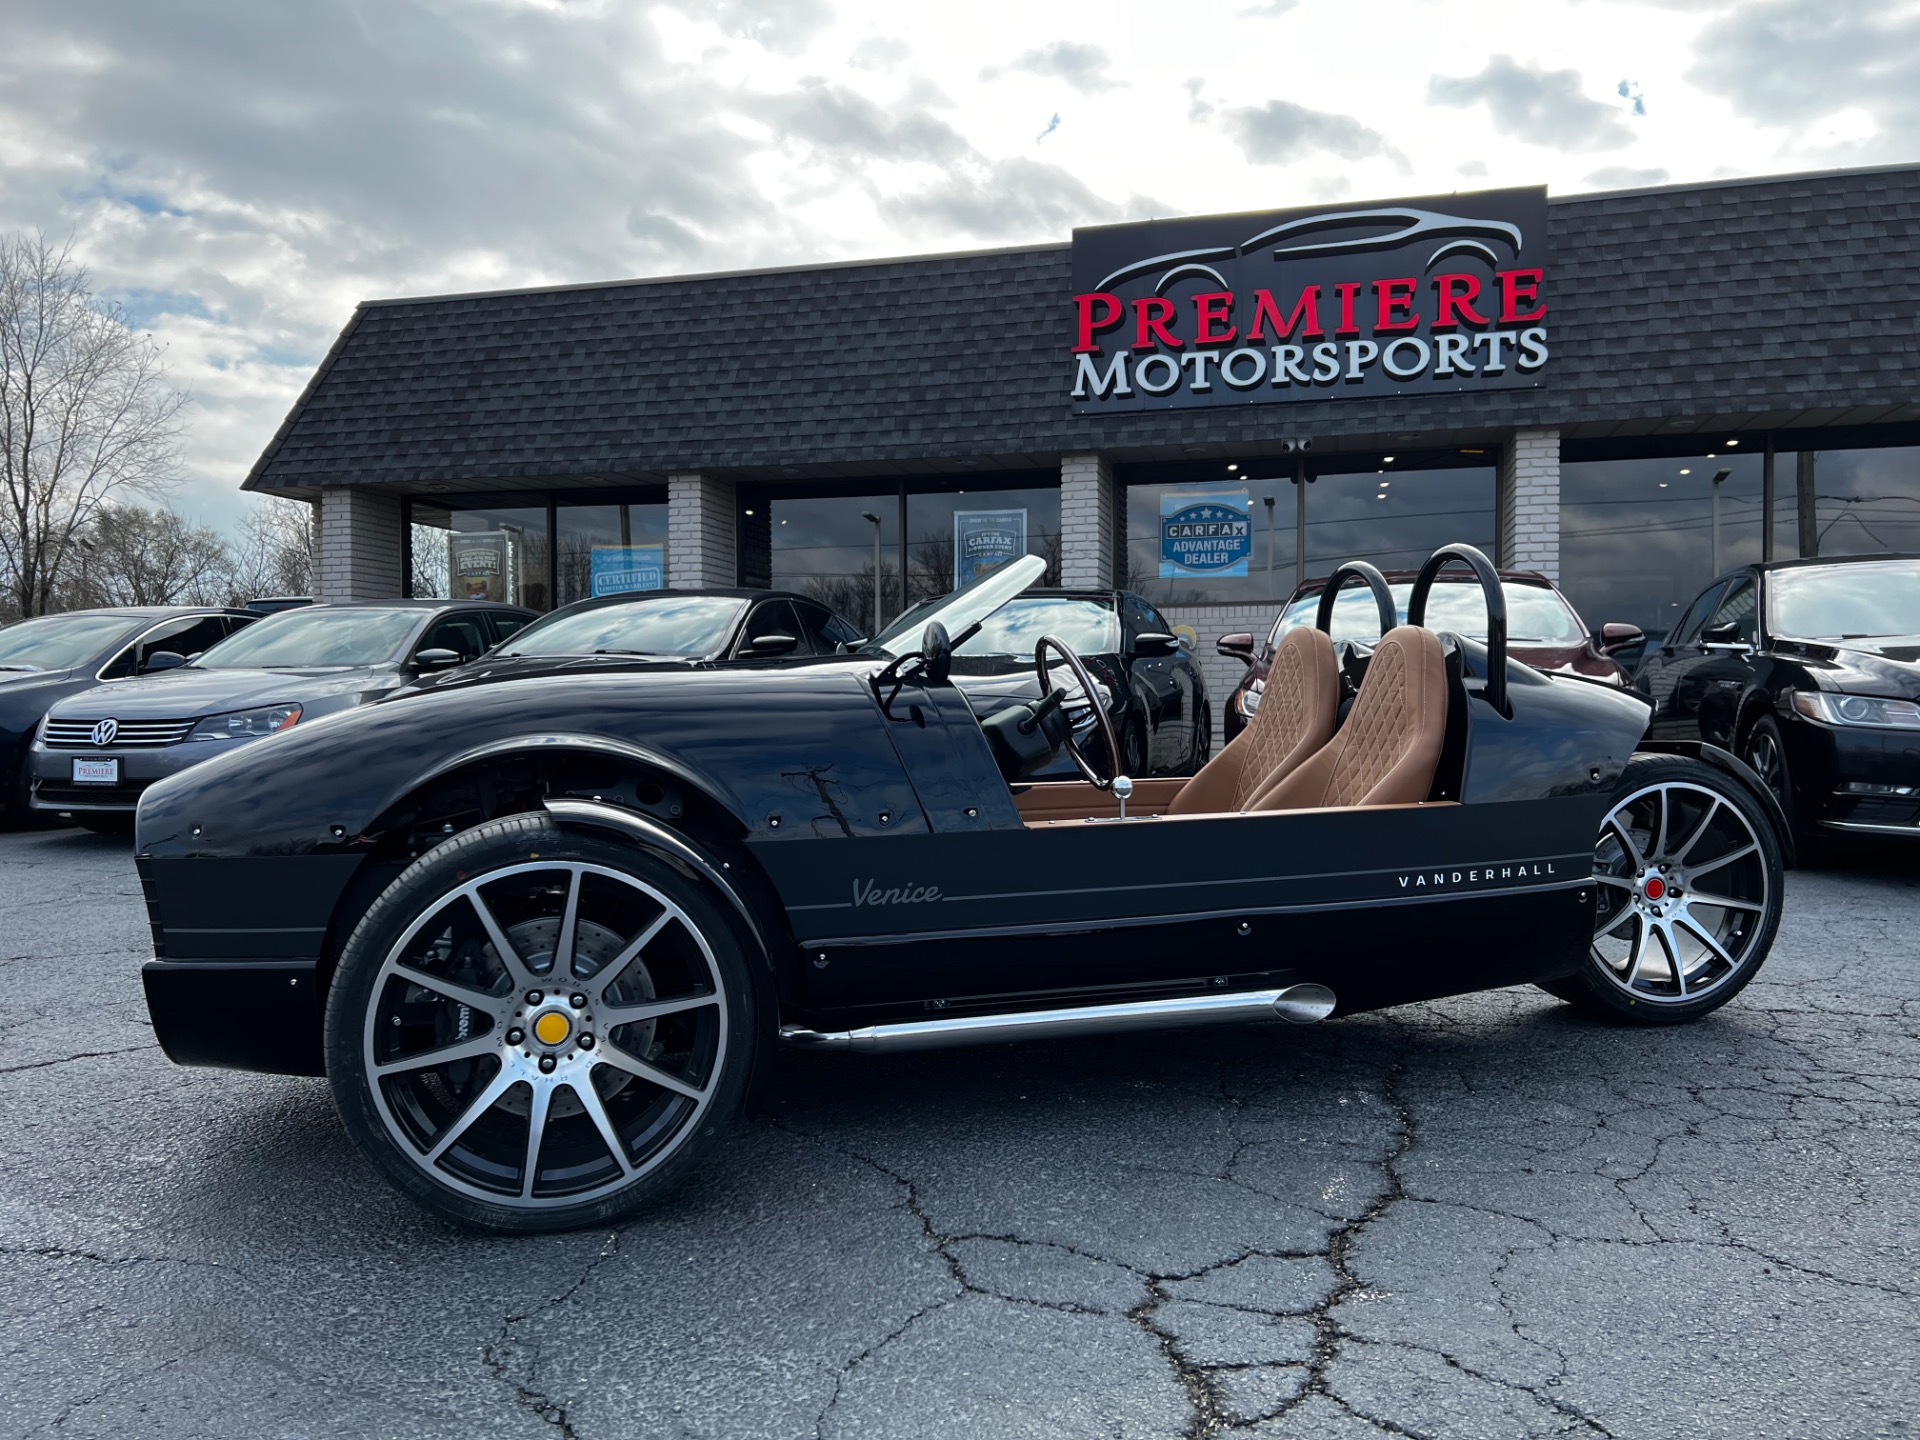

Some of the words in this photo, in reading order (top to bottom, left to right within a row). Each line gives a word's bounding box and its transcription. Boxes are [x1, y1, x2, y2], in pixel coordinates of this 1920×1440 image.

[1071, 268, 1548, 354] PREMIERE
[1070, 327, 1549, 397] MOTORSPORTS
[1168, 523, 1245, 537] CARFAX
[969, 536, 1013, 546] CARFAX
[1173, 539, 1241, 552] ADVANTAGE
[460, 560, 496, 570] EVENT!
[1184, 552, 1228, 564] DEALER
[599, 571, 656, 586] CERTIFIED
[600, 585, 624, 593] LIMITED
[624, 582, 656, 590] WARRANTY
[1399, 863, 1555, 888] VANDERHALL
[853, 878, 943, 907] Venice
